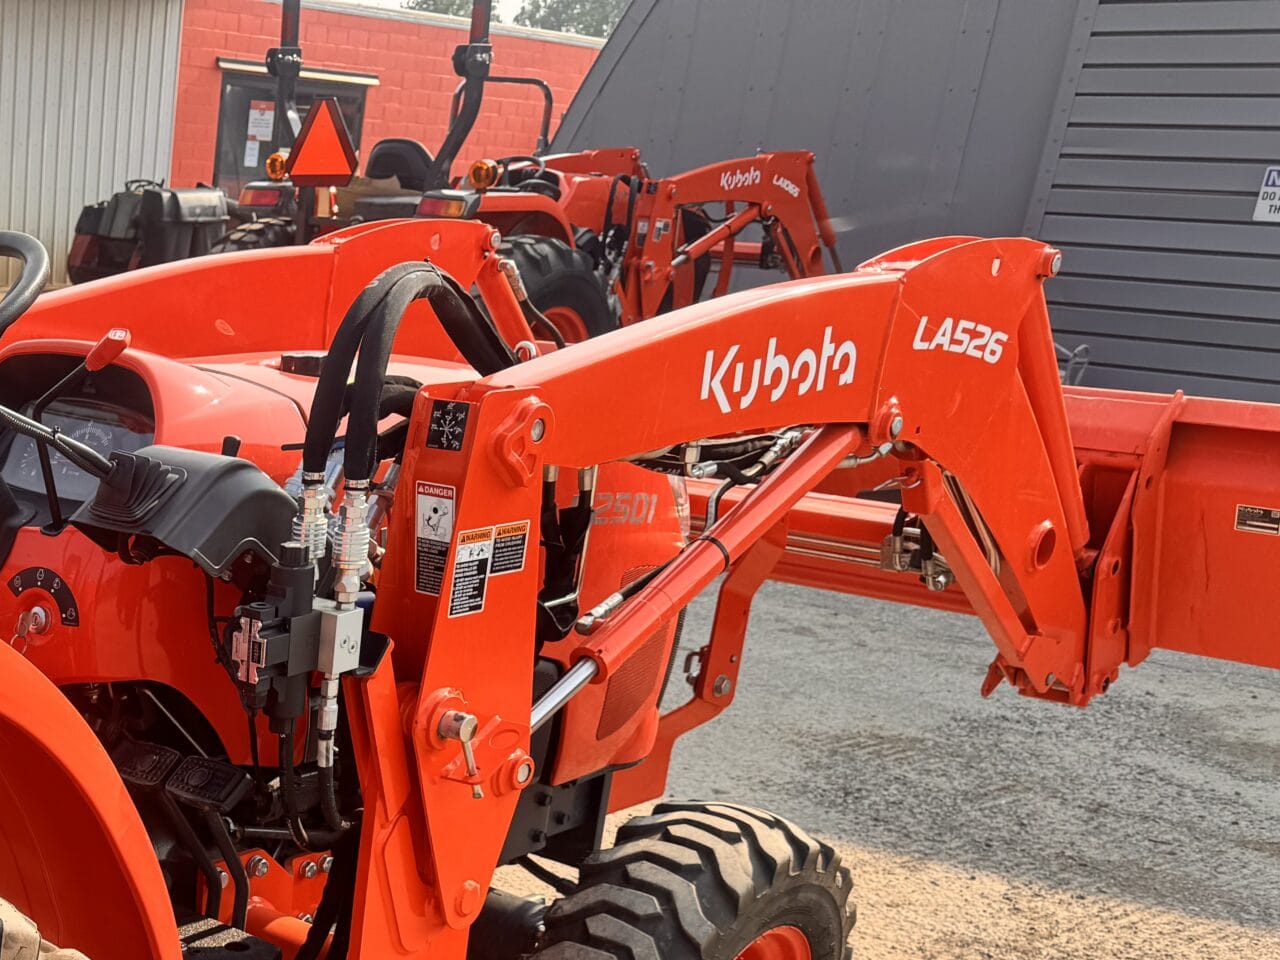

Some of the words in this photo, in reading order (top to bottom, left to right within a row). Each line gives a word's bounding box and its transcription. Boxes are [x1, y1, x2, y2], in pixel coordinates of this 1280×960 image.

[720, 166, 761, 191] Kubota
[1261, 191, 1276, 201] DO
[912, 315, 1009, 364] LA526
[700, 325, 857, 414] Kubota
[424, 486, 453, 497] DANGER
[501, 525, 526, 535] WARNING
[464, 531, 491, 542] WARNING
